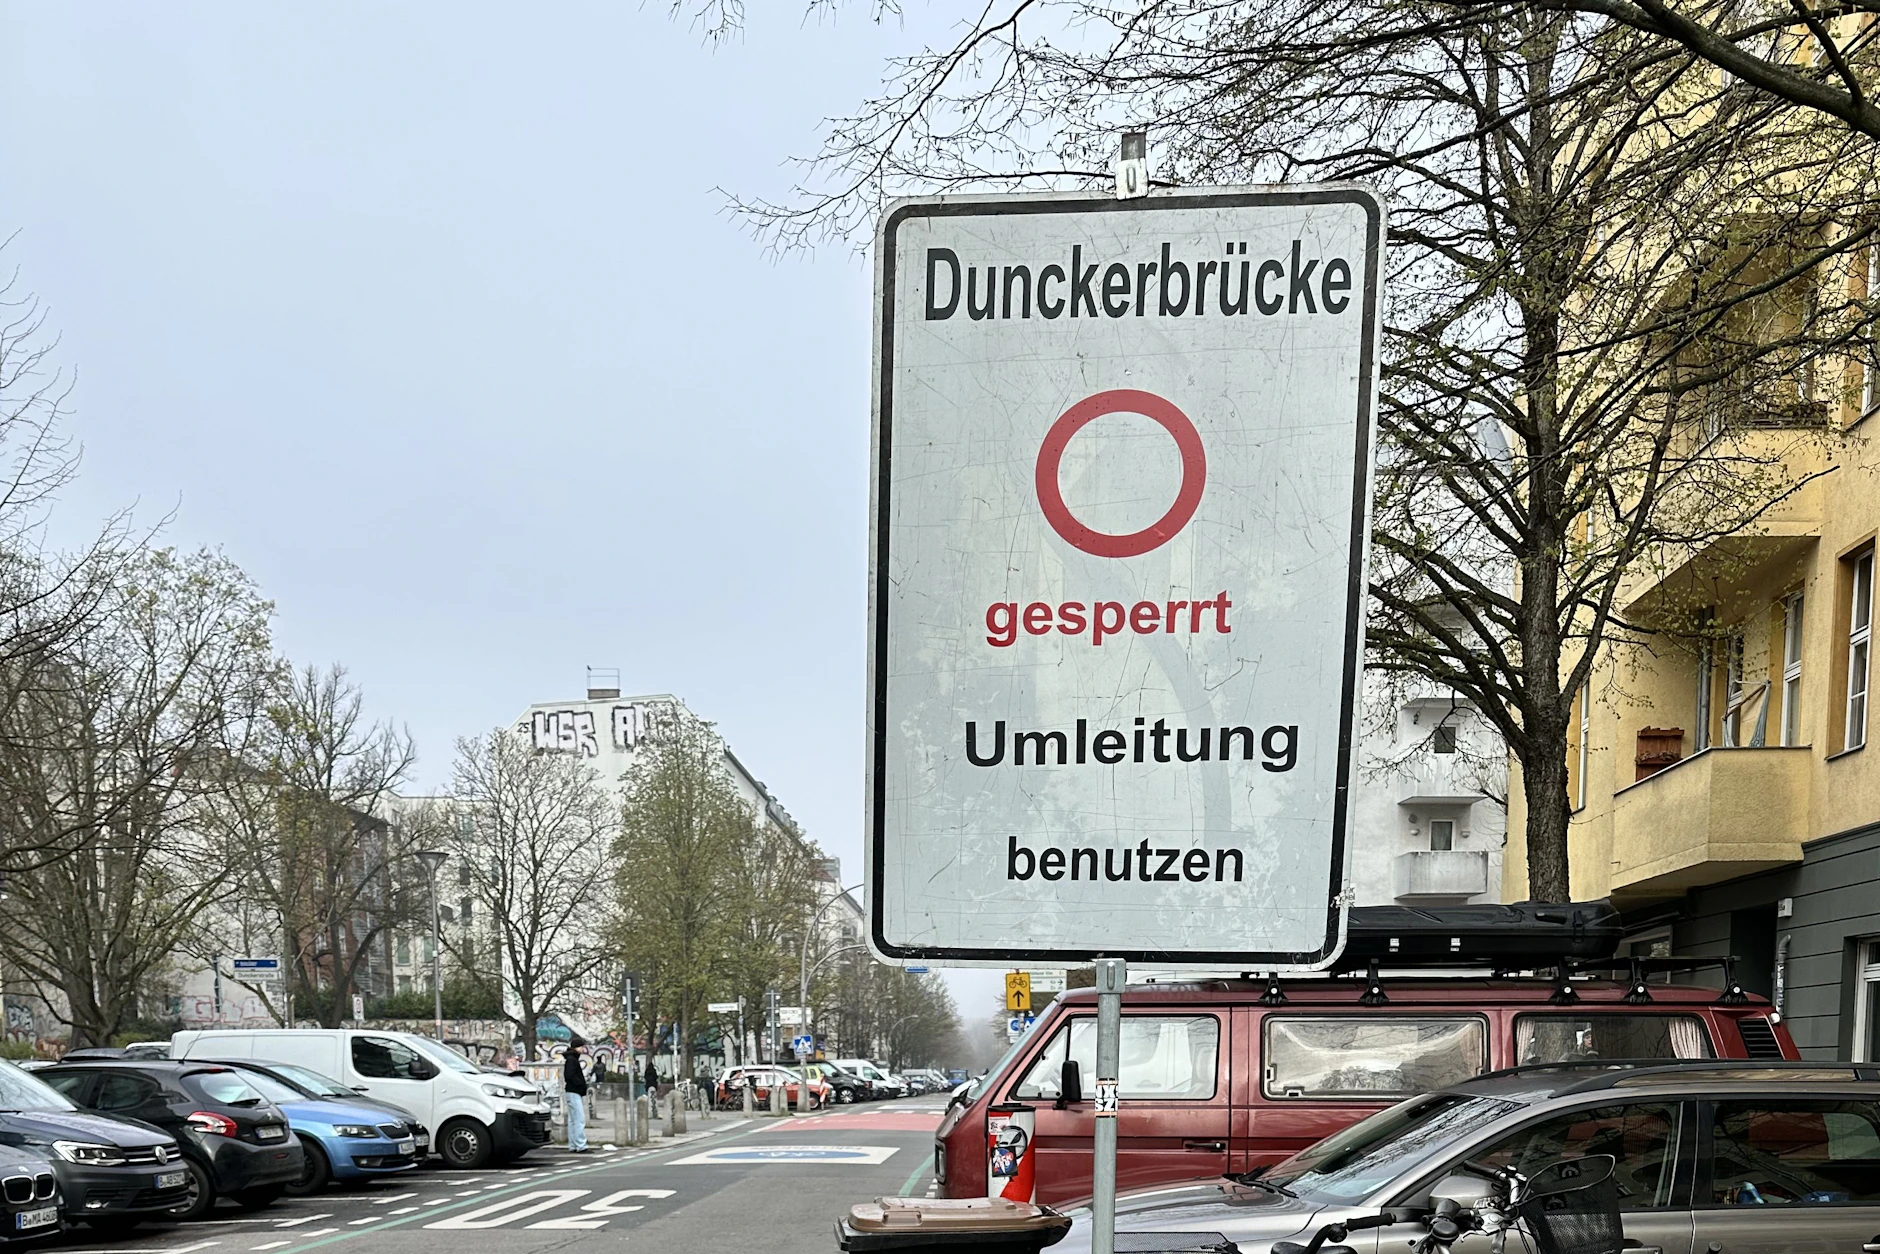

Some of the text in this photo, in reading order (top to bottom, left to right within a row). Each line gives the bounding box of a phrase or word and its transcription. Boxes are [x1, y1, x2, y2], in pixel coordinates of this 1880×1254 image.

[926, 240, 1352, 321] Dunckerbrücke
[986, 592, 1232, 648] gesperrt
[966, 717, 1299, 773] Umleitung
[1008, 836, 1244, 882] benutzen
[23, 1215, 29, 1227] B
